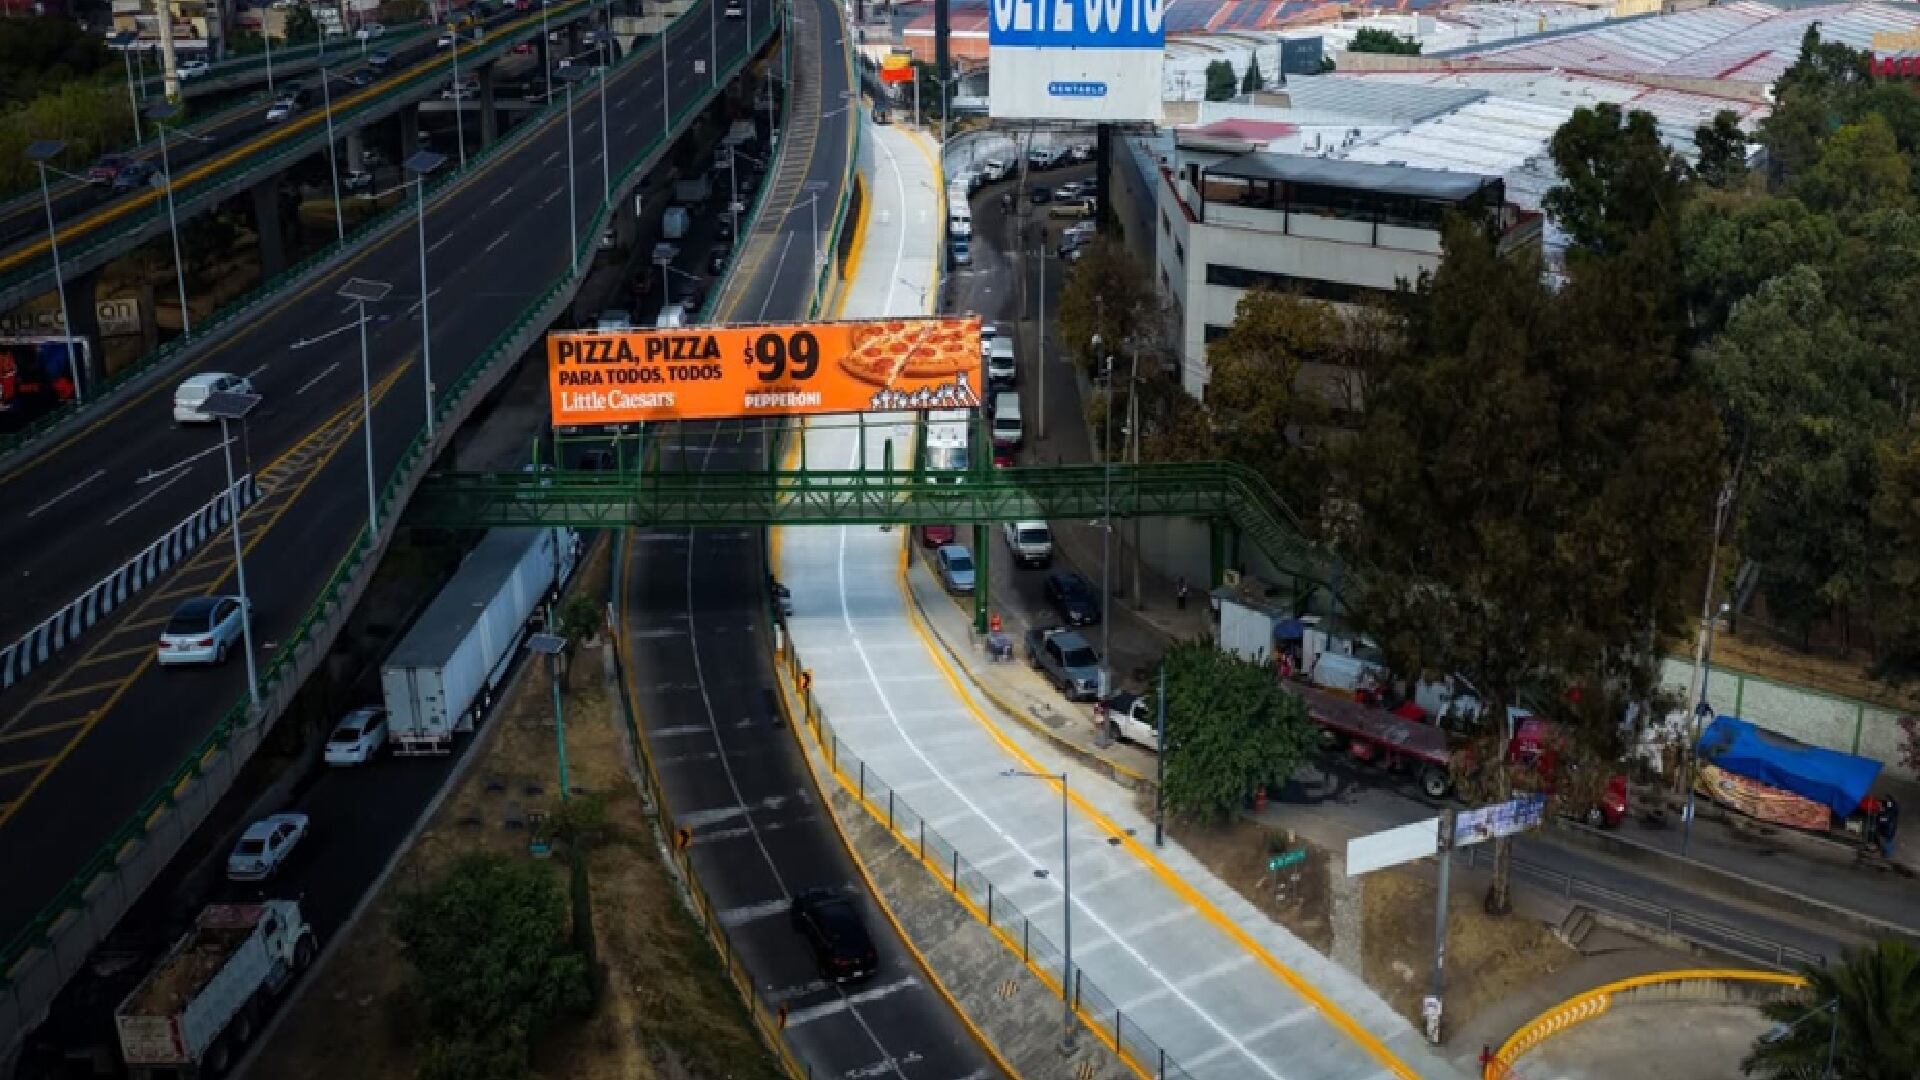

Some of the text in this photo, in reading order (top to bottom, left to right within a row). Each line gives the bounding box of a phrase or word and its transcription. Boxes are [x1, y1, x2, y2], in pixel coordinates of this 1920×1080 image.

[558, 335, 721, 365] PIZZA, PIZZA
[559, 364, 722, 385] PARA TODOS, TODOS
[562, 389, 675, 411] Little Caesars
[744, 391, 822, 408] PEPPERONI
